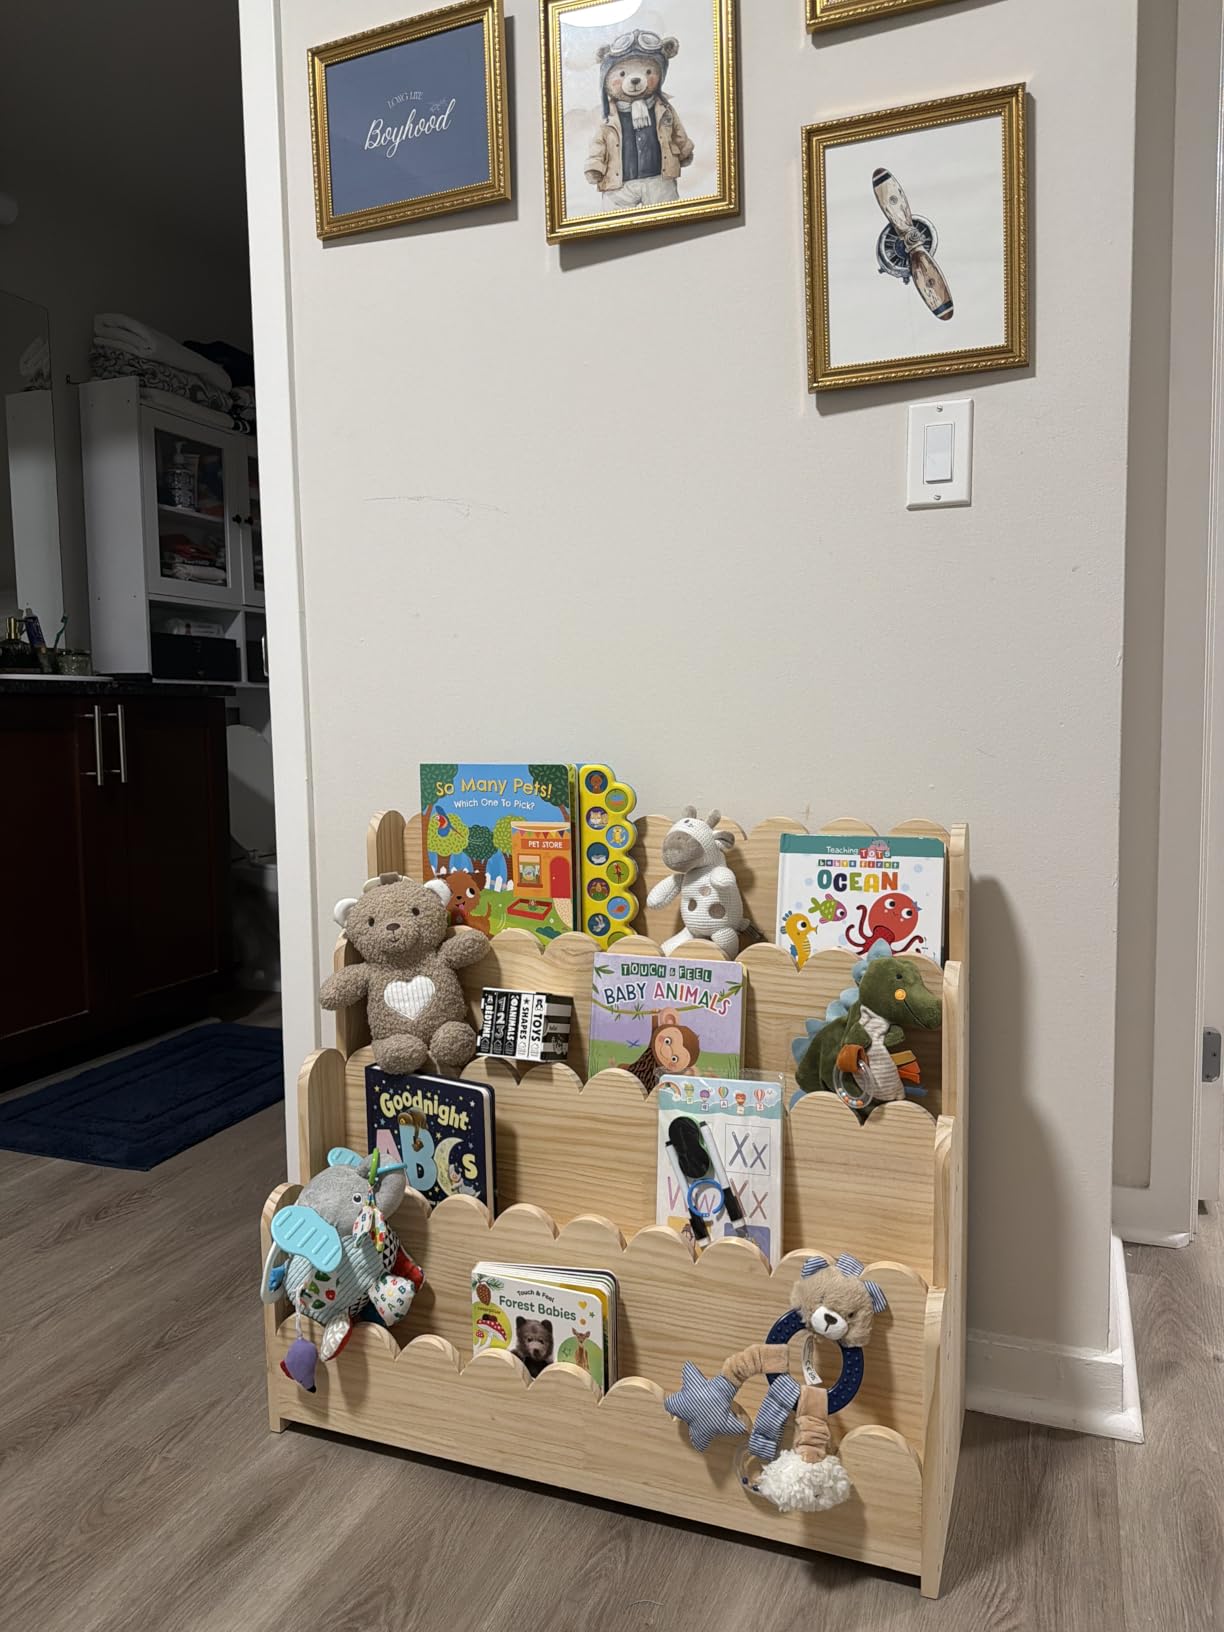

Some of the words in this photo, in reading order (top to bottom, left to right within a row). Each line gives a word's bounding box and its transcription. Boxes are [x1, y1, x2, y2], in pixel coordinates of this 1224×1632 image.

[364, 98, 456, 158] Boyhood
[435, 781, 455, 796] So
[461, 777, 507, 795] Many
[513, 778, 553, 799] Pets!
[453, 799, 479, 809] Which
[480, 798, 499, 807] One
[501, 798, 512, 808] To
[514, 800, 536, 810] Pick?
[528, 840, 540, 848] PET
[542, 841, 563, 849] STORE
[826, 846, 858, 856] Teaching
[817, 869, 898, 892] OCEAN
[621, 963, 666, 977] TOUCH
[669, 968, 676, 977] &
[679, 966, 712, 982] FEEL
[604, 982, 647, 1005] BABY
[654, 981, 731, 1016] ANIMALS
[482, 1005, 494, 1038] BEDTIME
[507, 1006, 518, 1041] ANIMALS
[520, 1006, 530, 1040] SHAPES
[532, 1013, 543, 1042] TOYS
[380, 1090, 469, 1131] Goodnight
[499, 1295, 535, 1313] Forest
[538, 1303, 577, 1321] Babies
[517, 1289, 534, 1297] Touch
[542, 1292, 555, 1303] Feel
